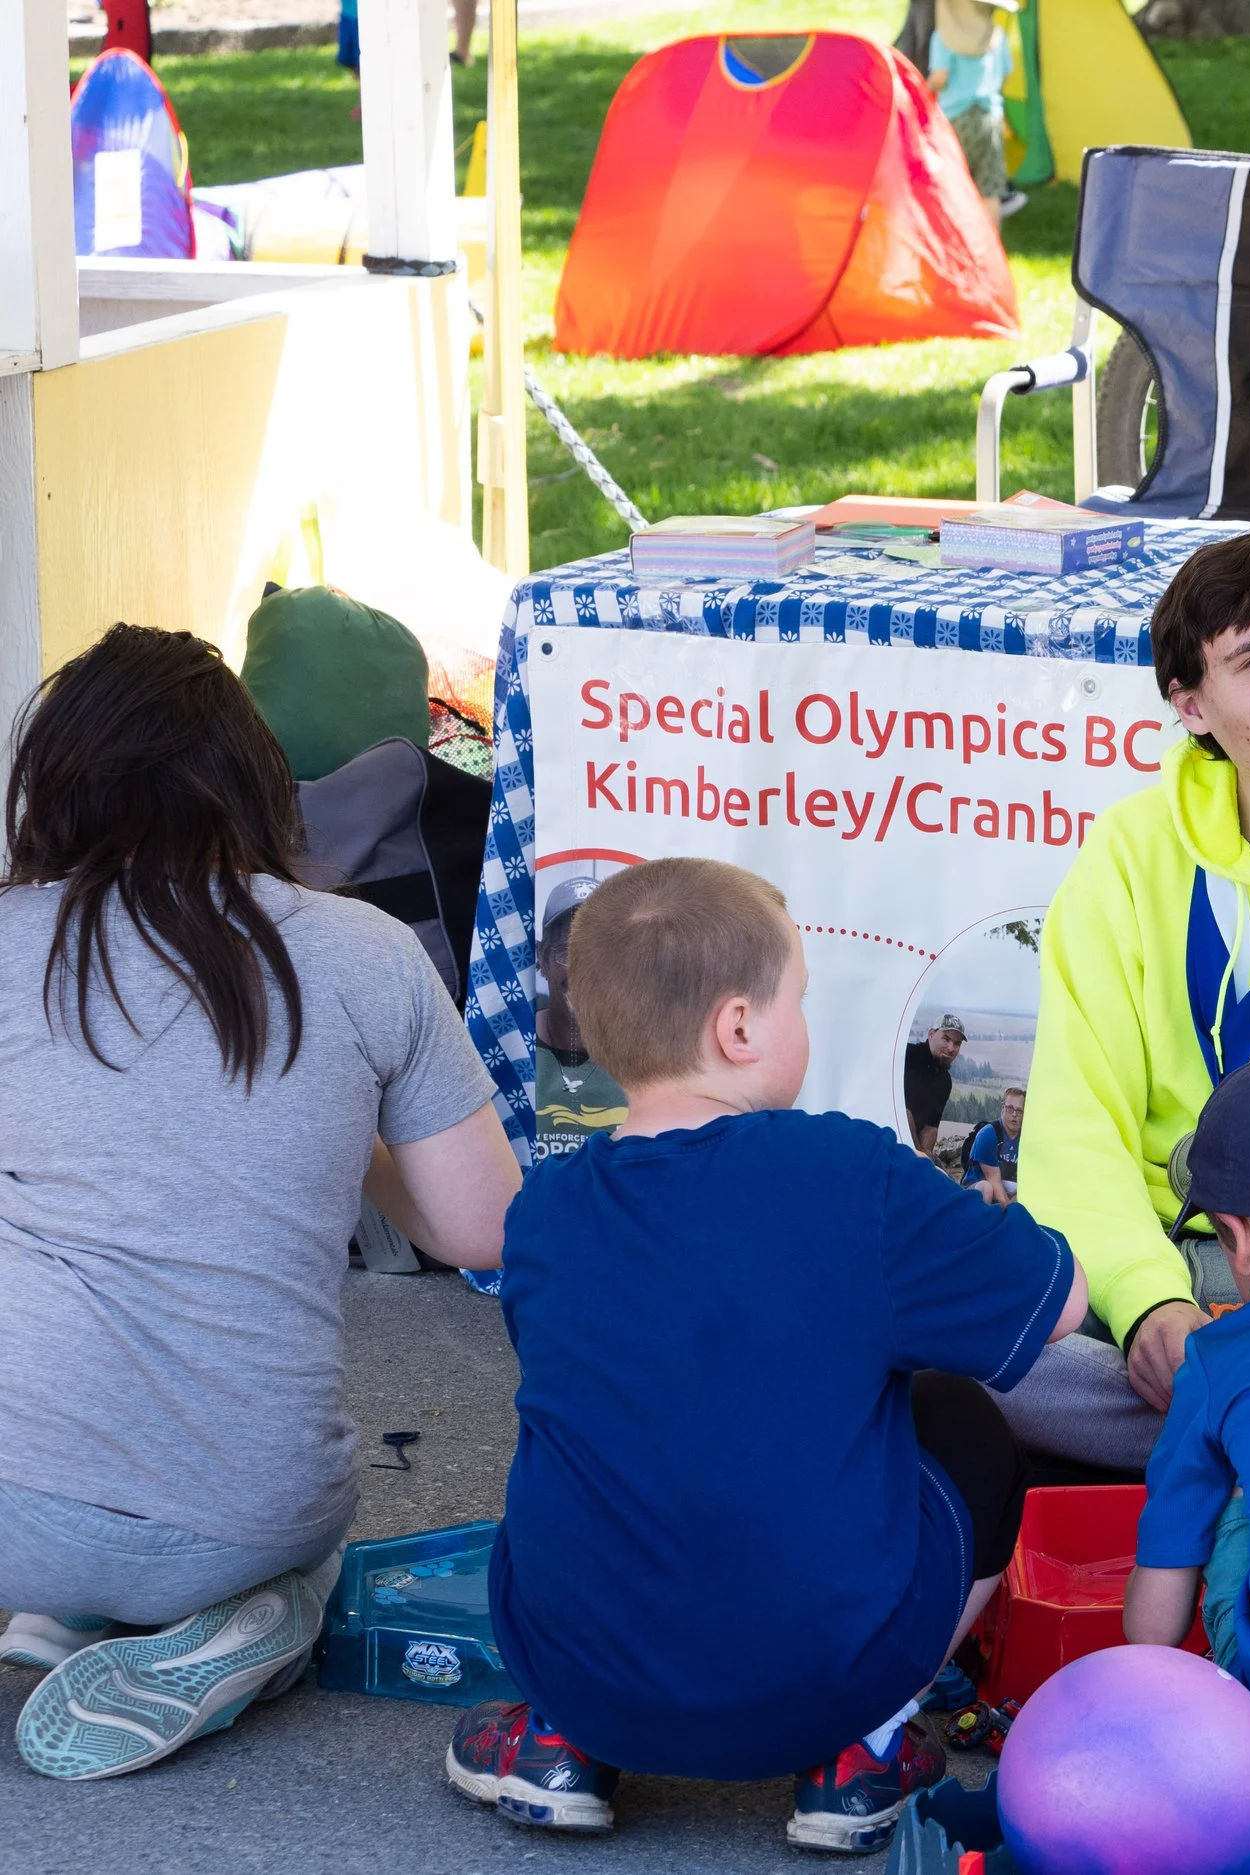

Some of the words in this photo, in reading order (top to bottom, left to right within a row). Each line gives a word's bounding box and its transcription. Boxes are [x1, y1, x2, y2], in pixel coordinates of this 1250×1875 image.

[581, 679, 775, 743] Special
[795, 690, 1068, 764] Olympics
[1085, 715, 1163, 772] BC
[543, 1133, 589, 1143] ENFORCE
[407, 1643, 459, 1664] MAX
[413, 1654, 456, 1668] STEEL
